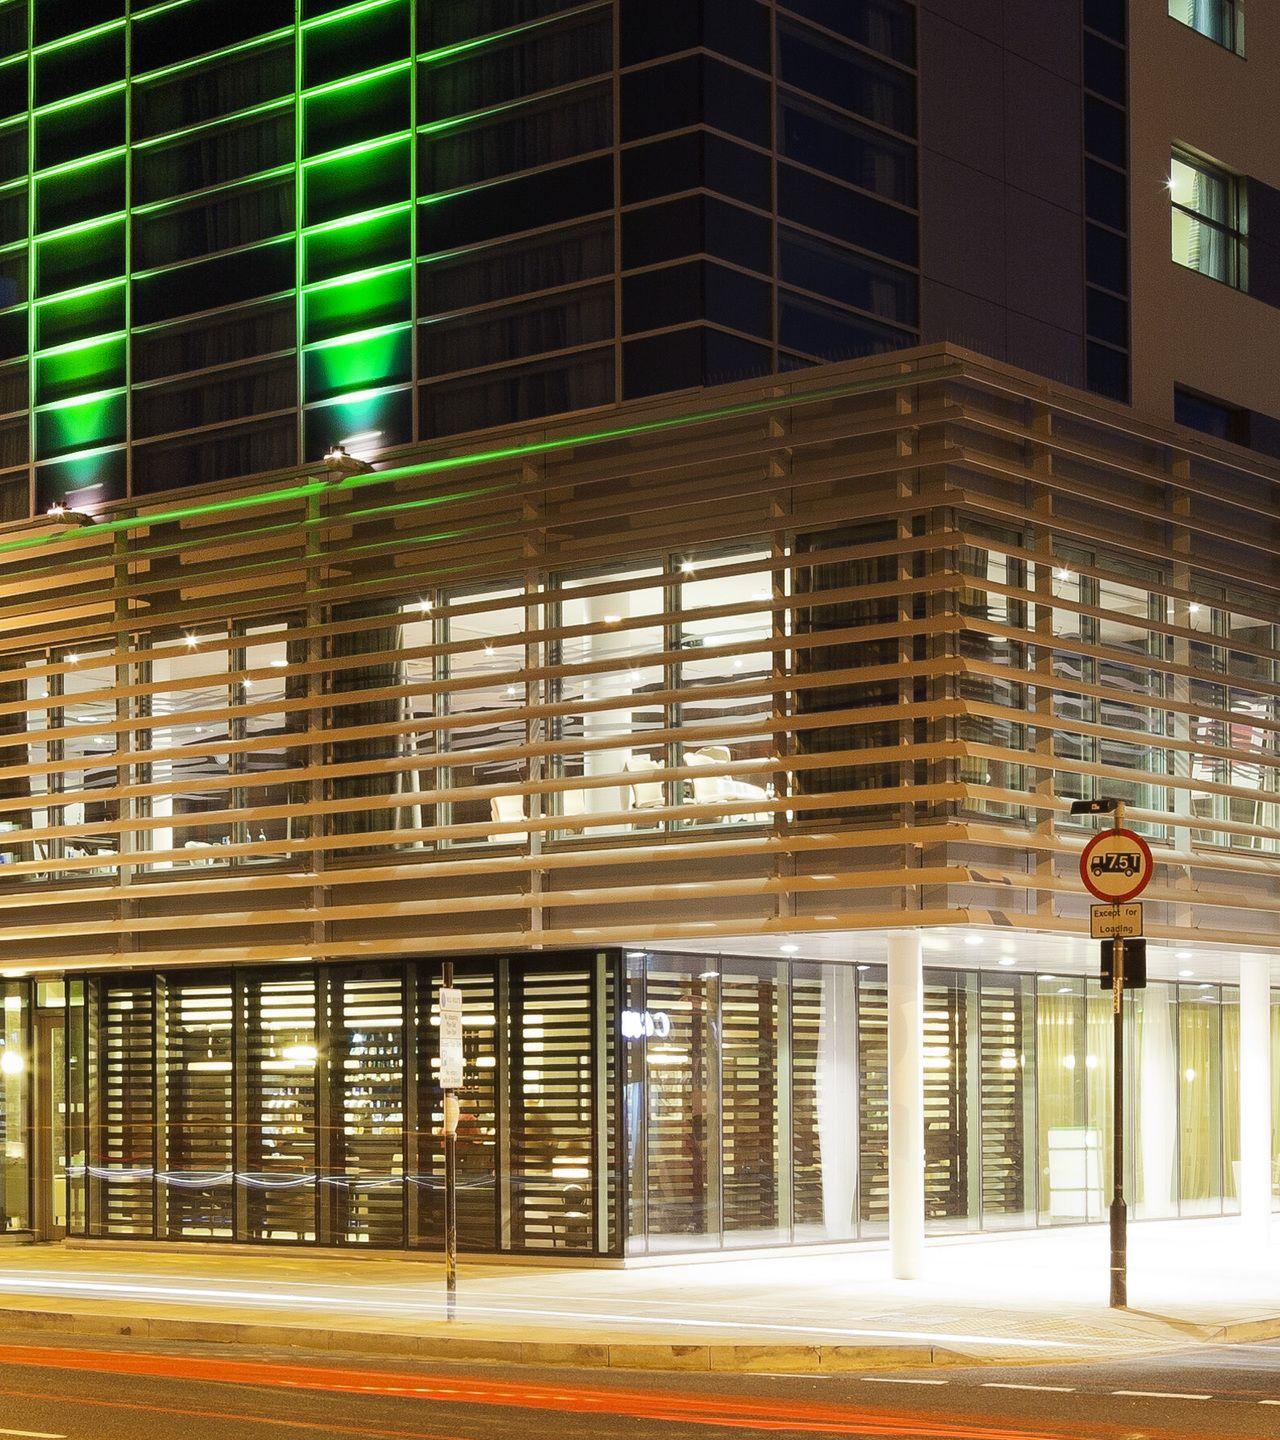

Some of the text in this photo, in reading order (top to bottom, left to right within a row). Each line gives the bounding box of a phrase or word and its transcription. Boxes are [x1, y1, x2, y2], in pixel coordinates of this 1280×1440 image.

[1094, 908, 1137, 919] Except for
[1100, 924, 1133, 934] Loading
